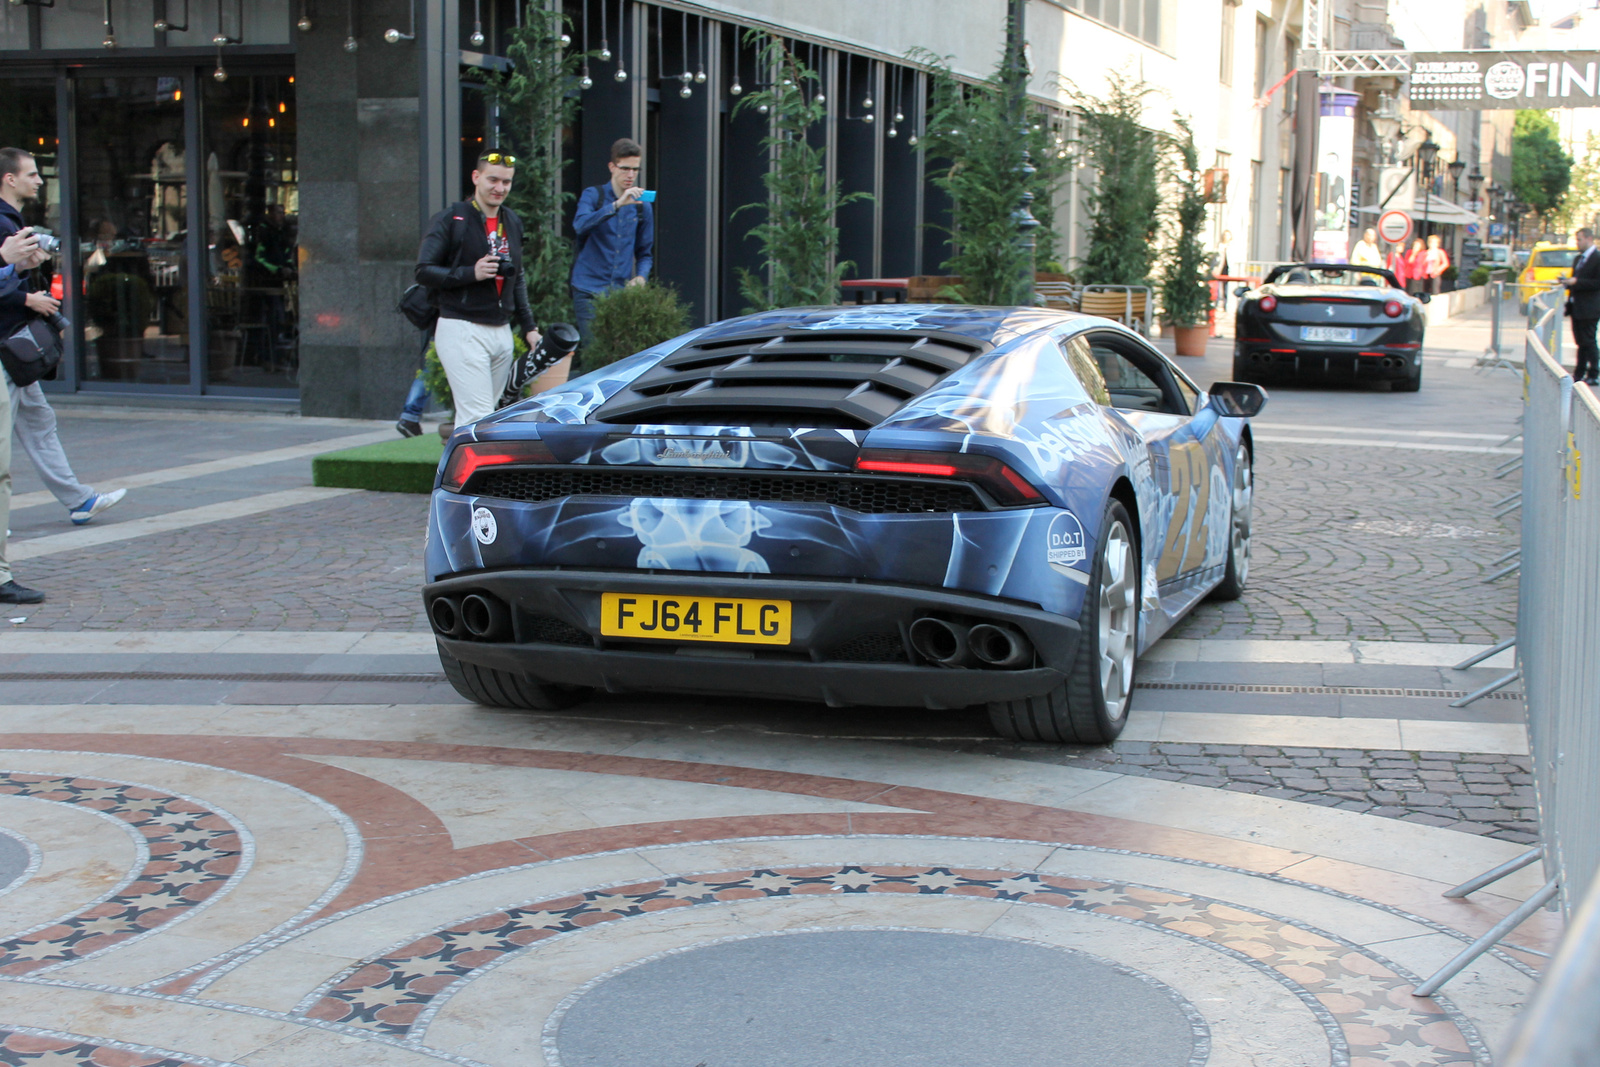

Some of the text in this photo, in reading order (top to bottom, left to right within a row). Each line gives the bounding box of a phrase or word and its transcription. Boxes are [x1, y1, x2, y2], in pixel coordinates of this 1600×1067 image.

[1415, 62, 1479, 73] DUBLIN TO
[1411, 73, 1483, 84] BUCHAREST
[1526, 61, 1600, 97] FIN
[657, 447, 730, 461] Lamborghini
[1156, 442, 1210, 582] 22
[1048, 549, 1084, 559] SHIPPED BY
[618, 598, 779, 636] FJ64 FLG
